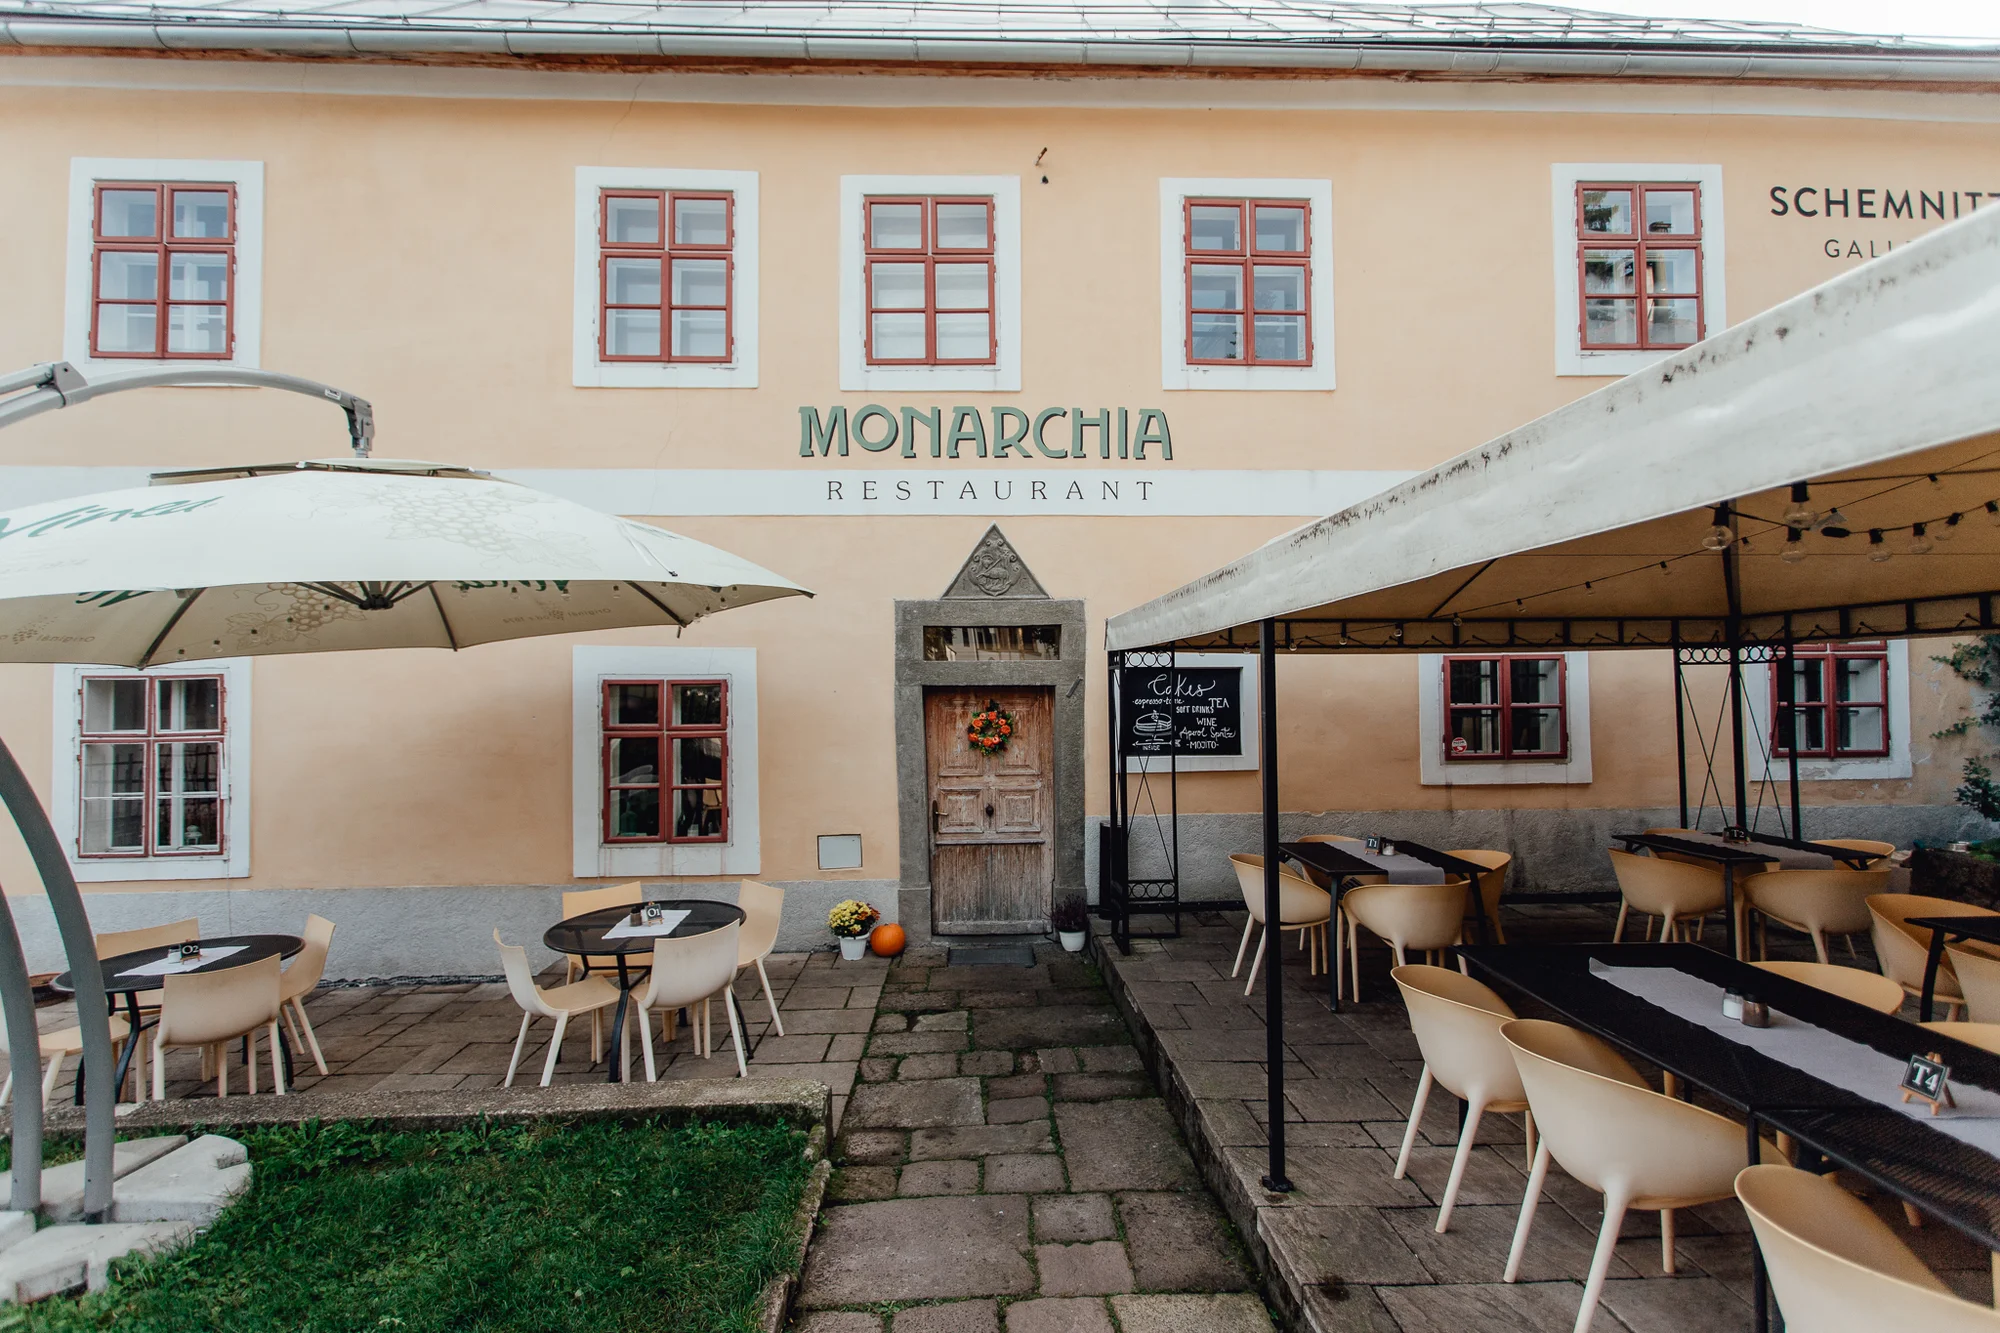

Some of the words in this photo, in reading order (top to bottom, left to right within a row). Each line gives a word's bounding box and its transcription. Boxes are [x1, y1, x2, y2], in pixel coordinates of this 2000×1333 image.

[1769, 186, 2000, 219] SCHEMNIT
[798, 403, 1174, 460] MONARCHIA
[827, 480, 1154, 501] RESTAURANT
[1208, 697, 1229, 708] TEA
[1196, 717, 1218, 727] WINE
[1911, 1062, 1939, 1094] T4
